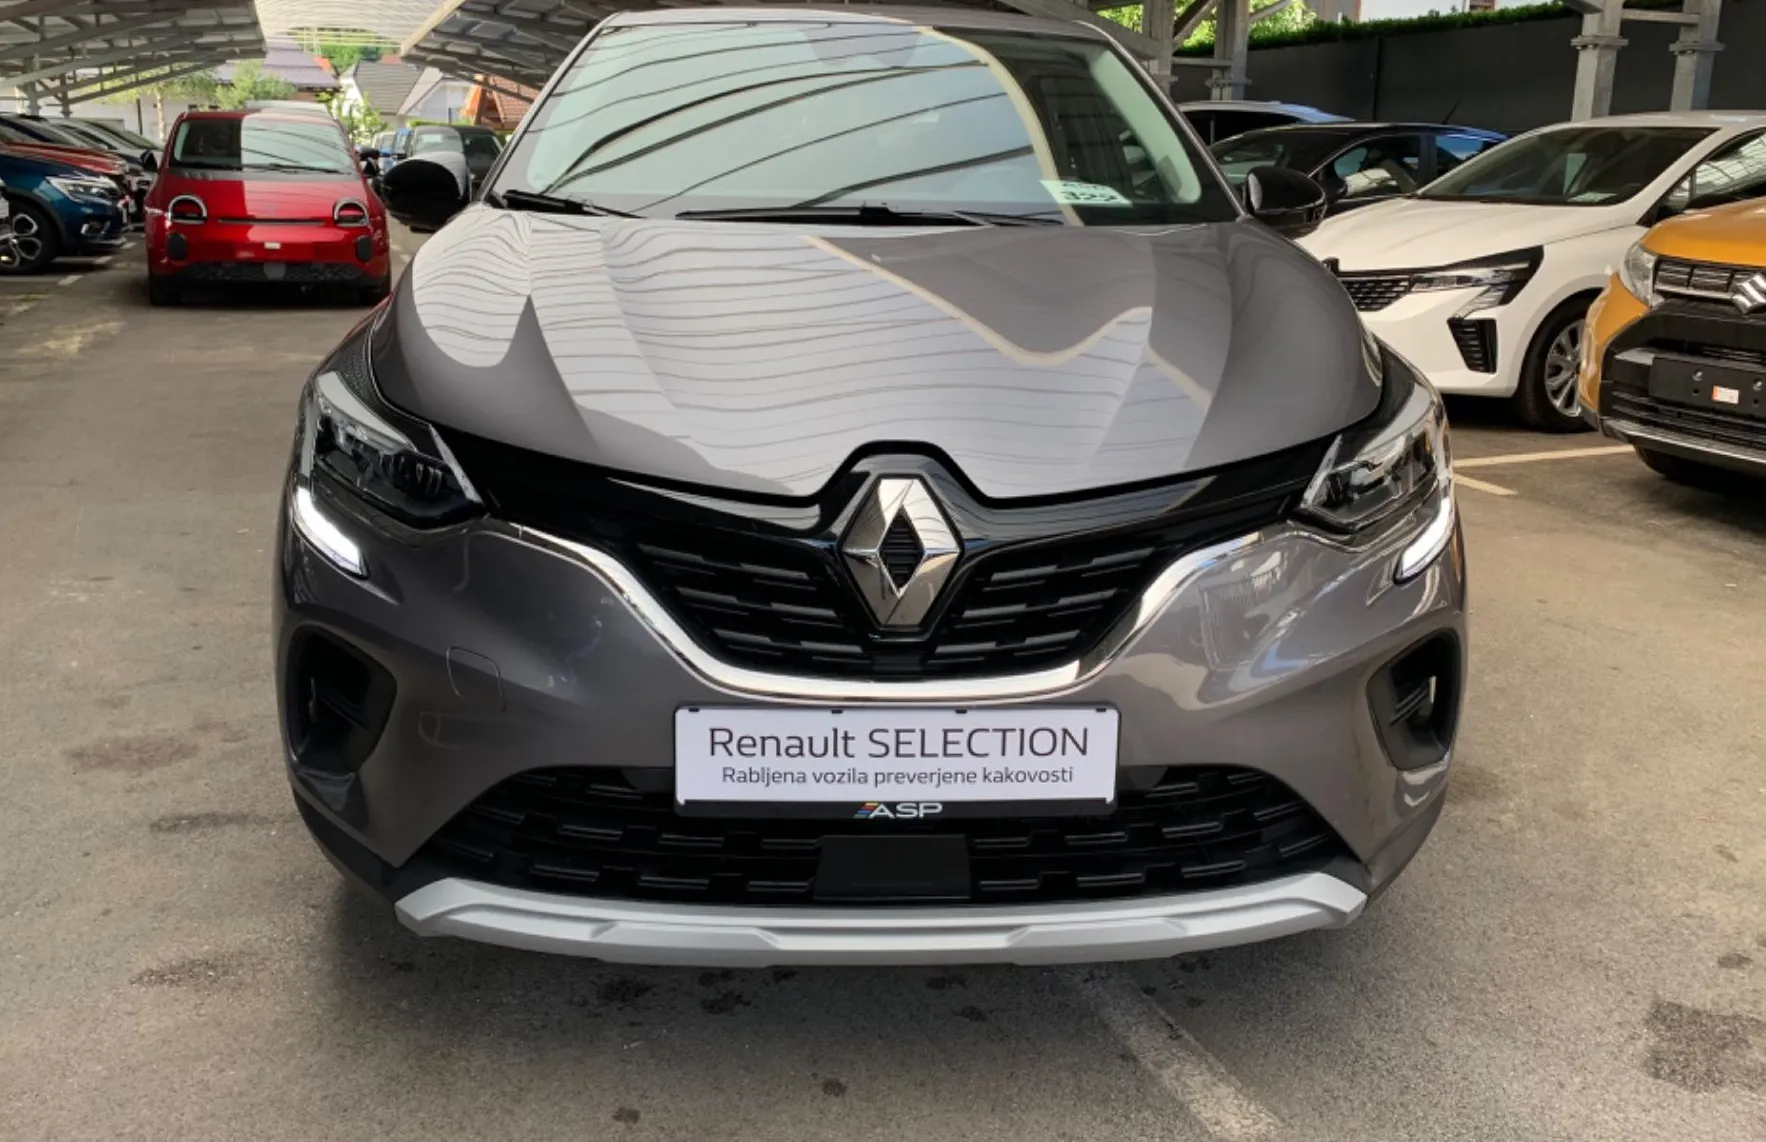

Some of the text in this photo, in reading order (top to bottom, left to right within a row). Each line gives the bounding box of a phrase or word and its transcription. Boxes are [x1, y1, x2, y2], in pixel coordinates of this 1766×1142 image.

[708, 727, 1088, 758] Renault SELECTION
[722, 766, 1073, 788] Rabljena vozila preverjene kakovosti
[868, 802, 943, 819] ASP
